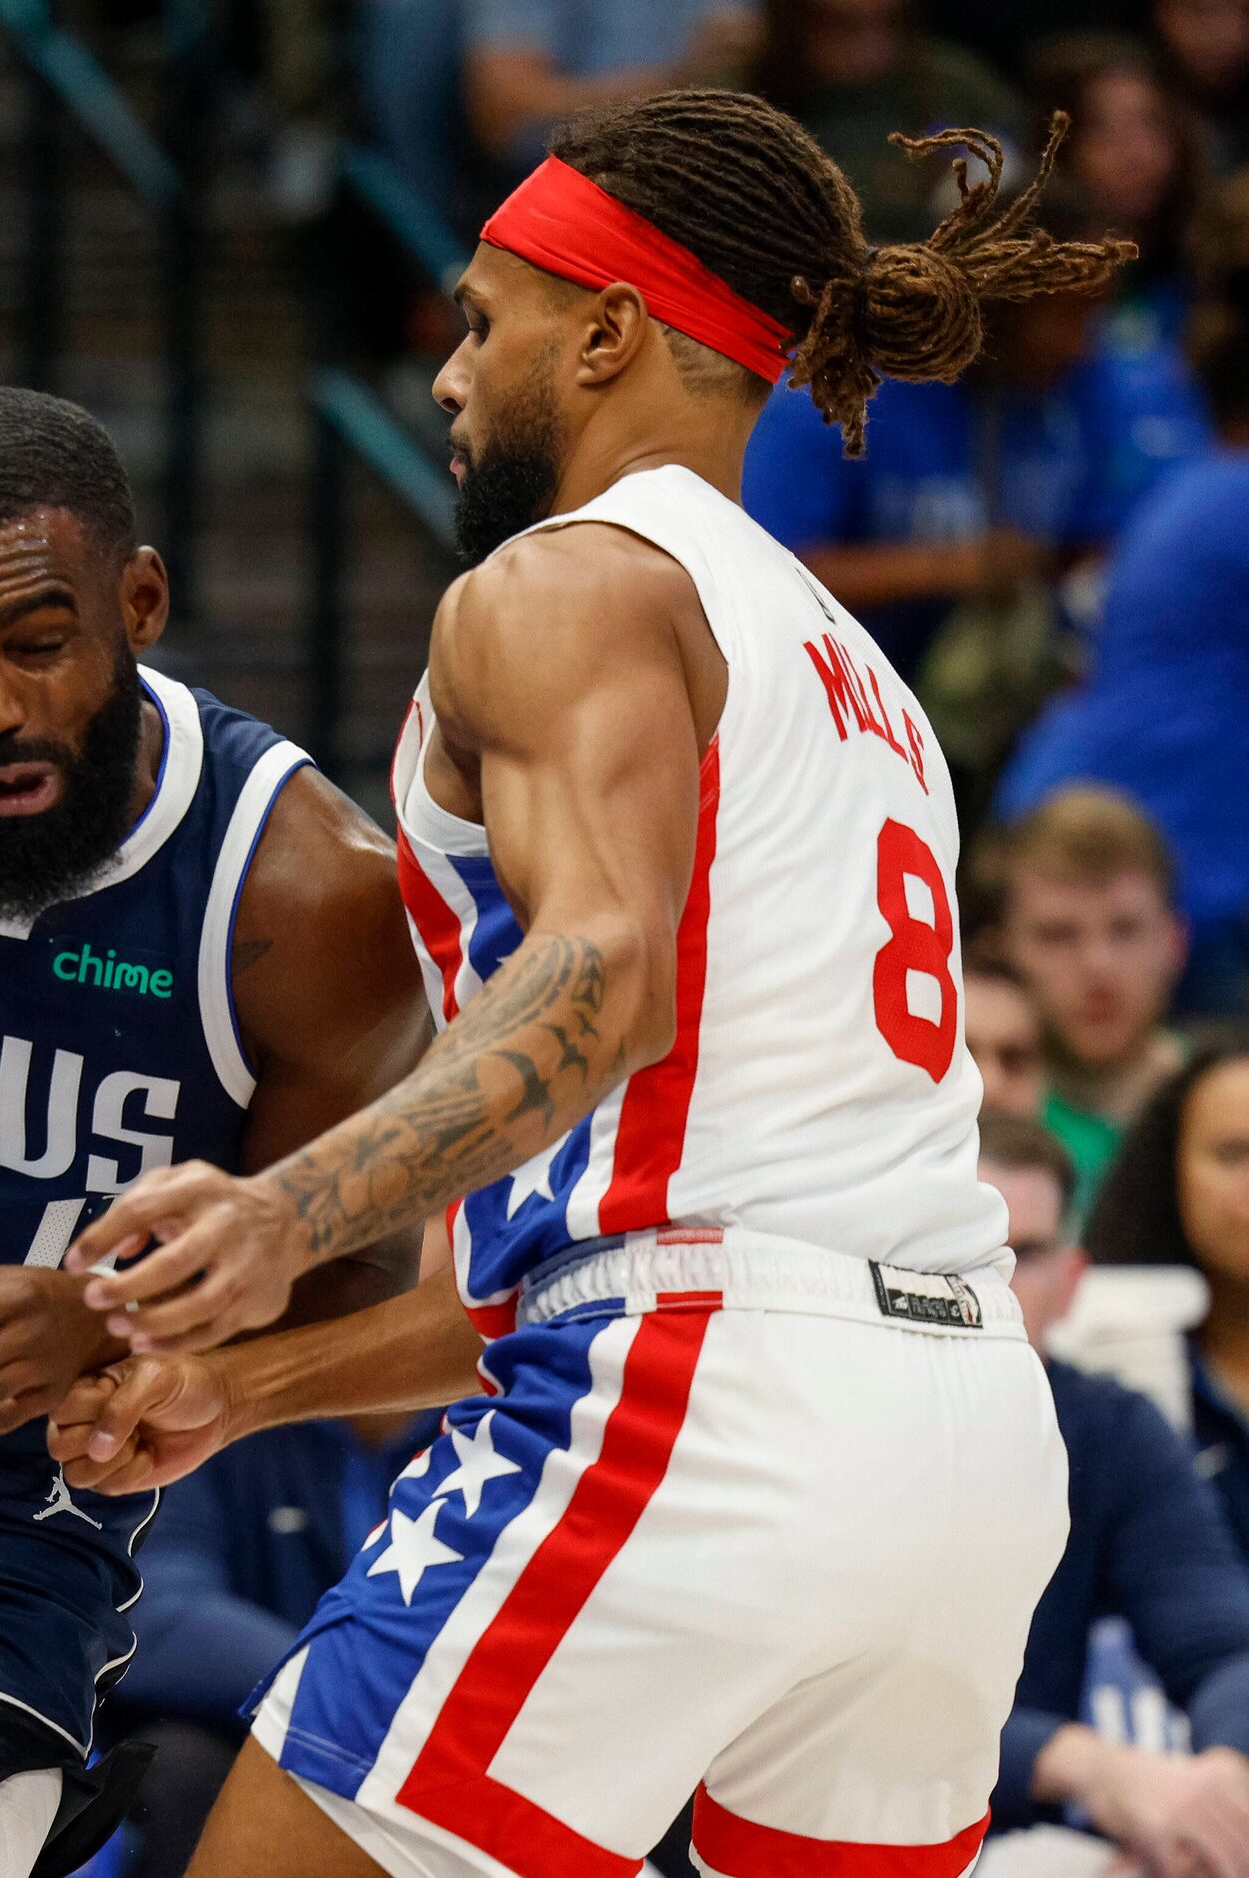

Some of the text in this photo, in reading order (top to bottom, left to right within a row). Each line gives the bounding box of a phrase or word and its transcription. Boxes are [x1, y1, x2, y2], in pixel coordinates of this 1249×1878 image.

[802, 632, 930, 796] MILLS
[53, 943, 174, 999] chime
[872, 816, 958, 1085] 8
